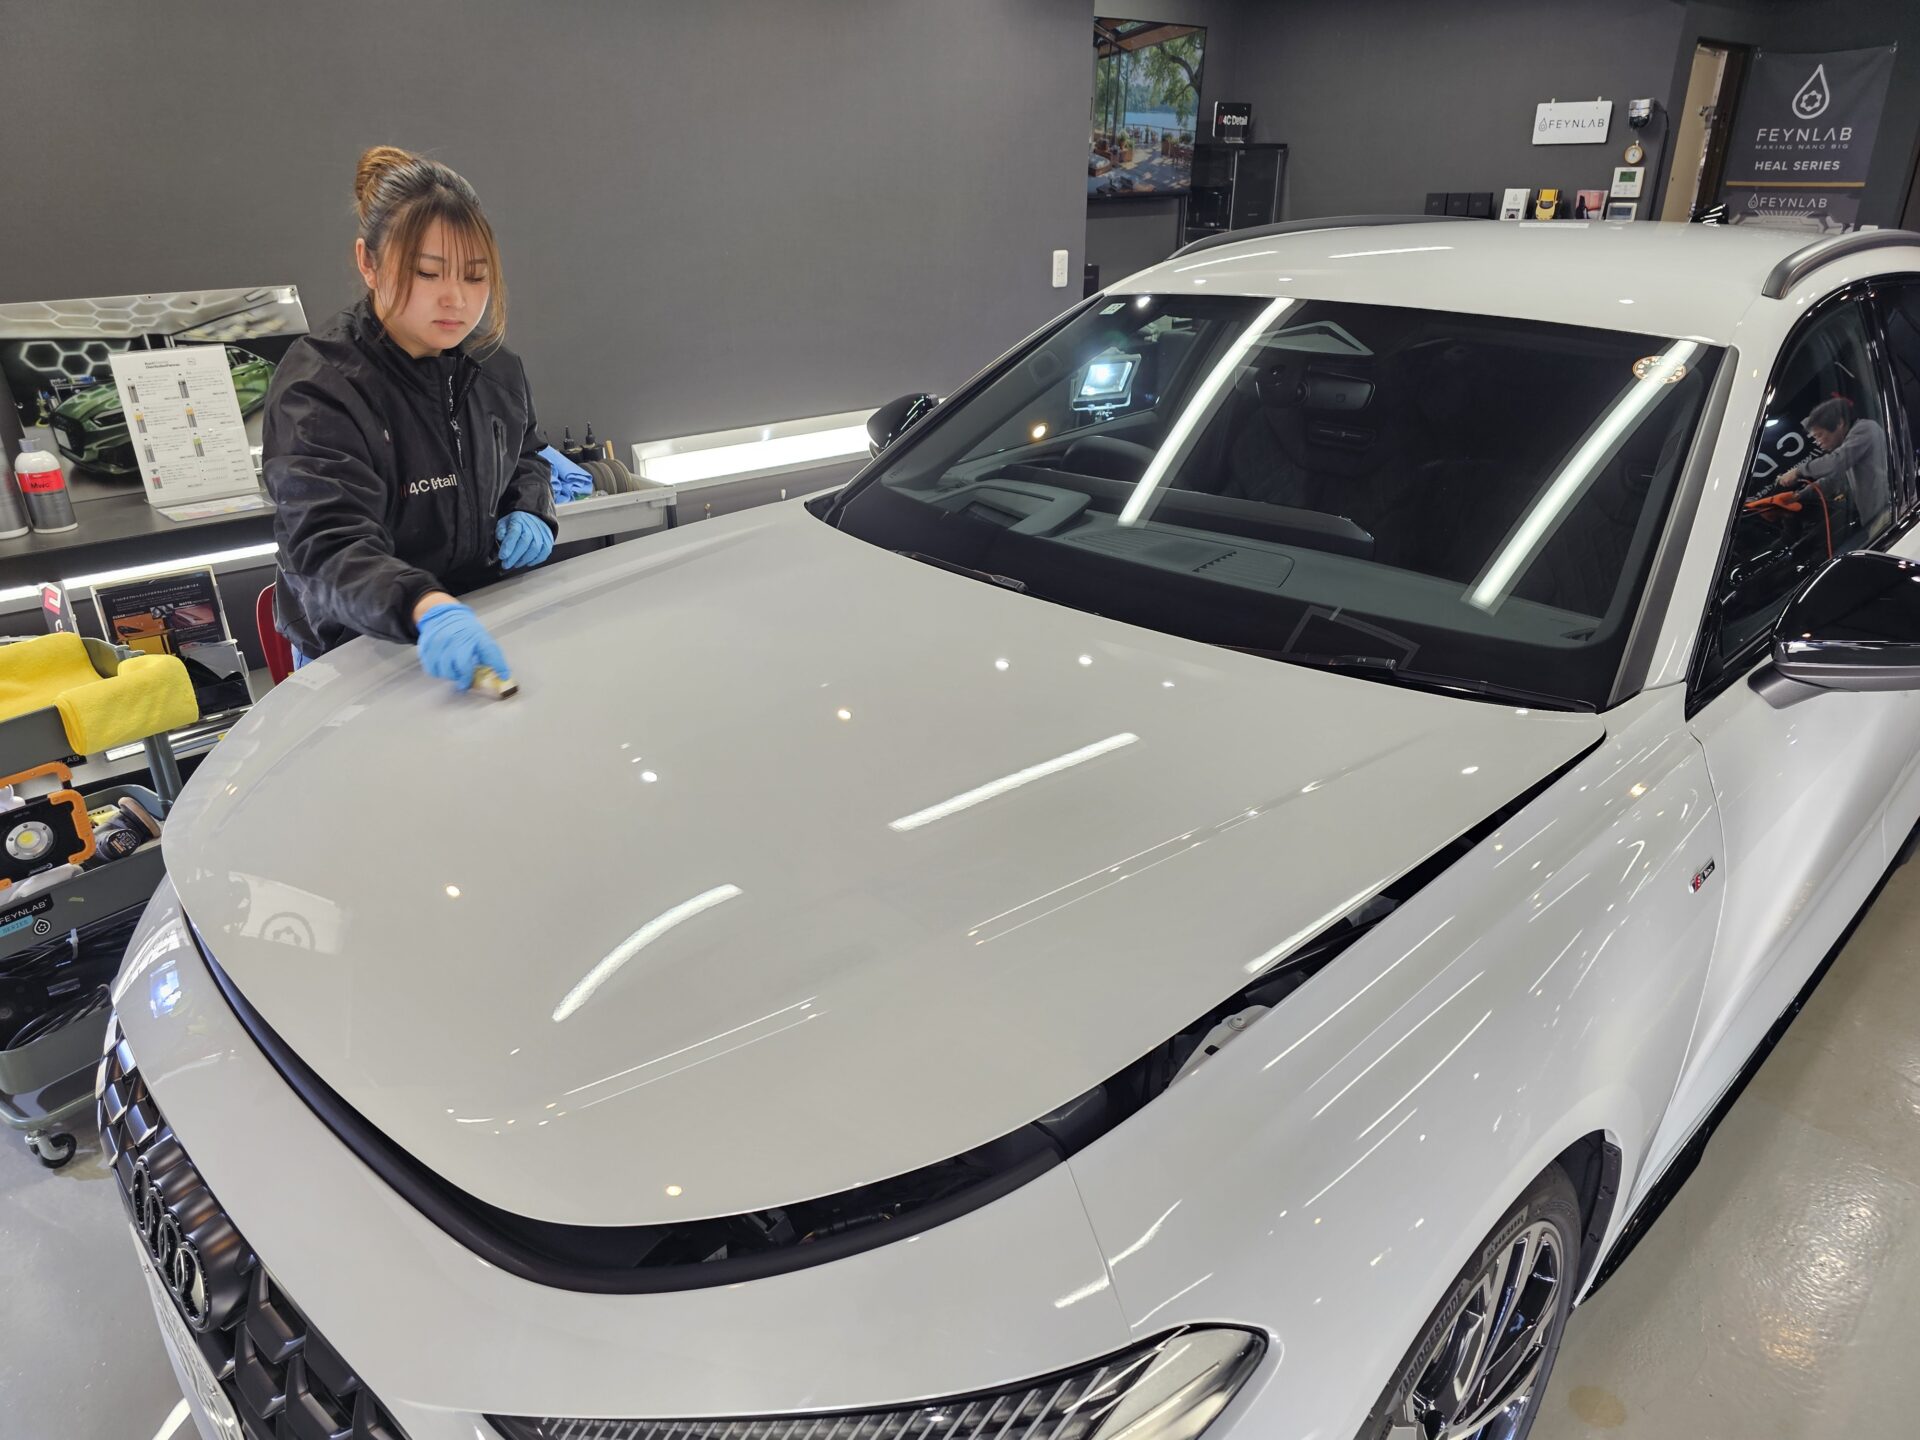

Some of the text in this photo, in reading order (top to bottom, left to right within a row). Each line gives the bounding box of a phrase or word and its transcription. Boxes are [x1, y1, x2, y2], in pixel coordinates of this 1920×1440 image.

[1548, 118, 1605, 129] FEYNLAB
[1756, 127, 1852, 142] FEYNLAB
[1754, 160, 1841, 171] HEAL SERIES
[1759, 197, 1828, 209] FEYNLAB
[409, 478, 430, 495] 4C
